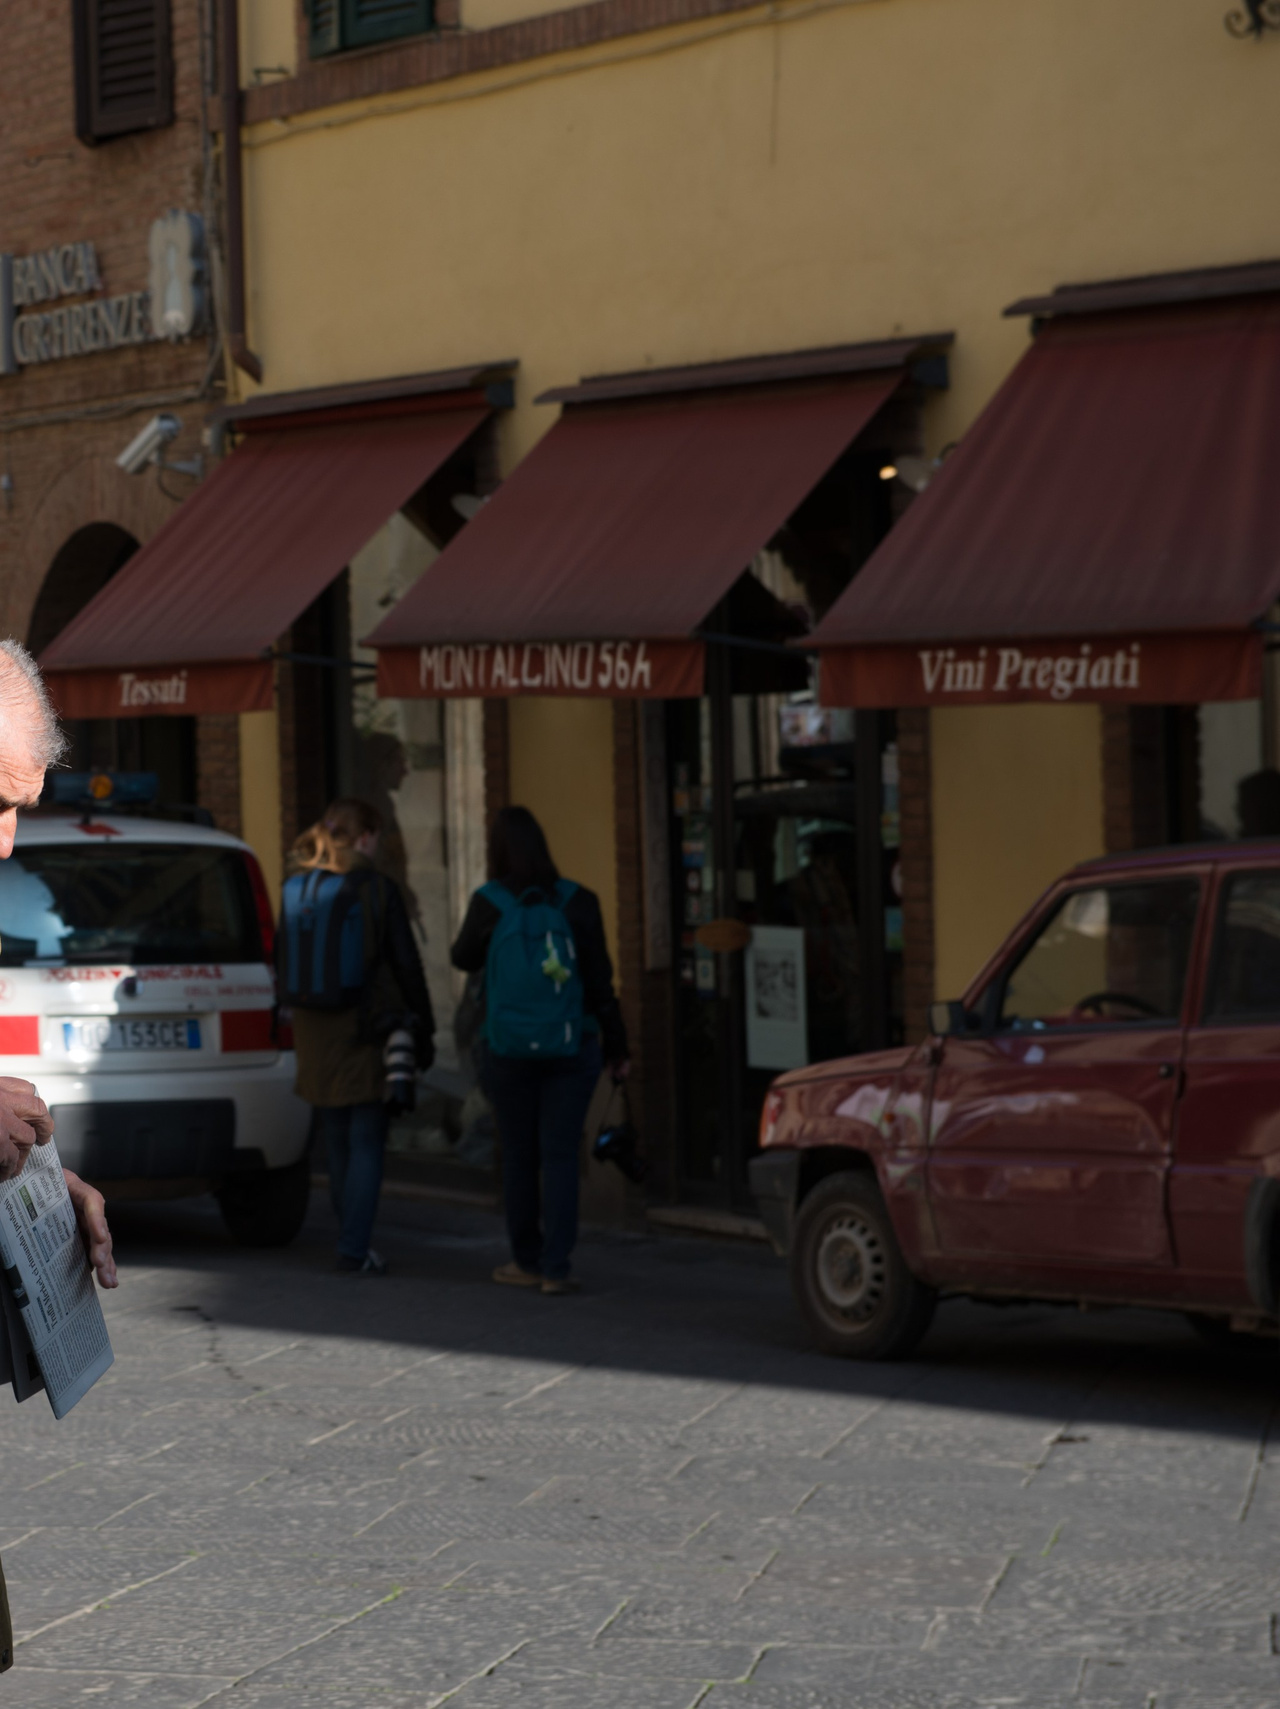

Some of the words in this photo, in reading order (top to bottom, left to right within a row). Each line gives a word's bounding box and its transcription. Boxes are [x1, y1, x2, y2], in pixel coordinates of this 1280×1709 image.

[420, 641, 595, 690] MONTALCINO
[919, 646, 987, 693] Vini
[992, 643, 1140, 699] Pregiati
[39, 1175, 53, 1196] pagine
[3, 1198, 22, 1232] profughi
[19, 1235, 36, 1269] rimanda
[31, 1267, 40, 1277] ci
[46, 1303, 58, 1330] Truffa
